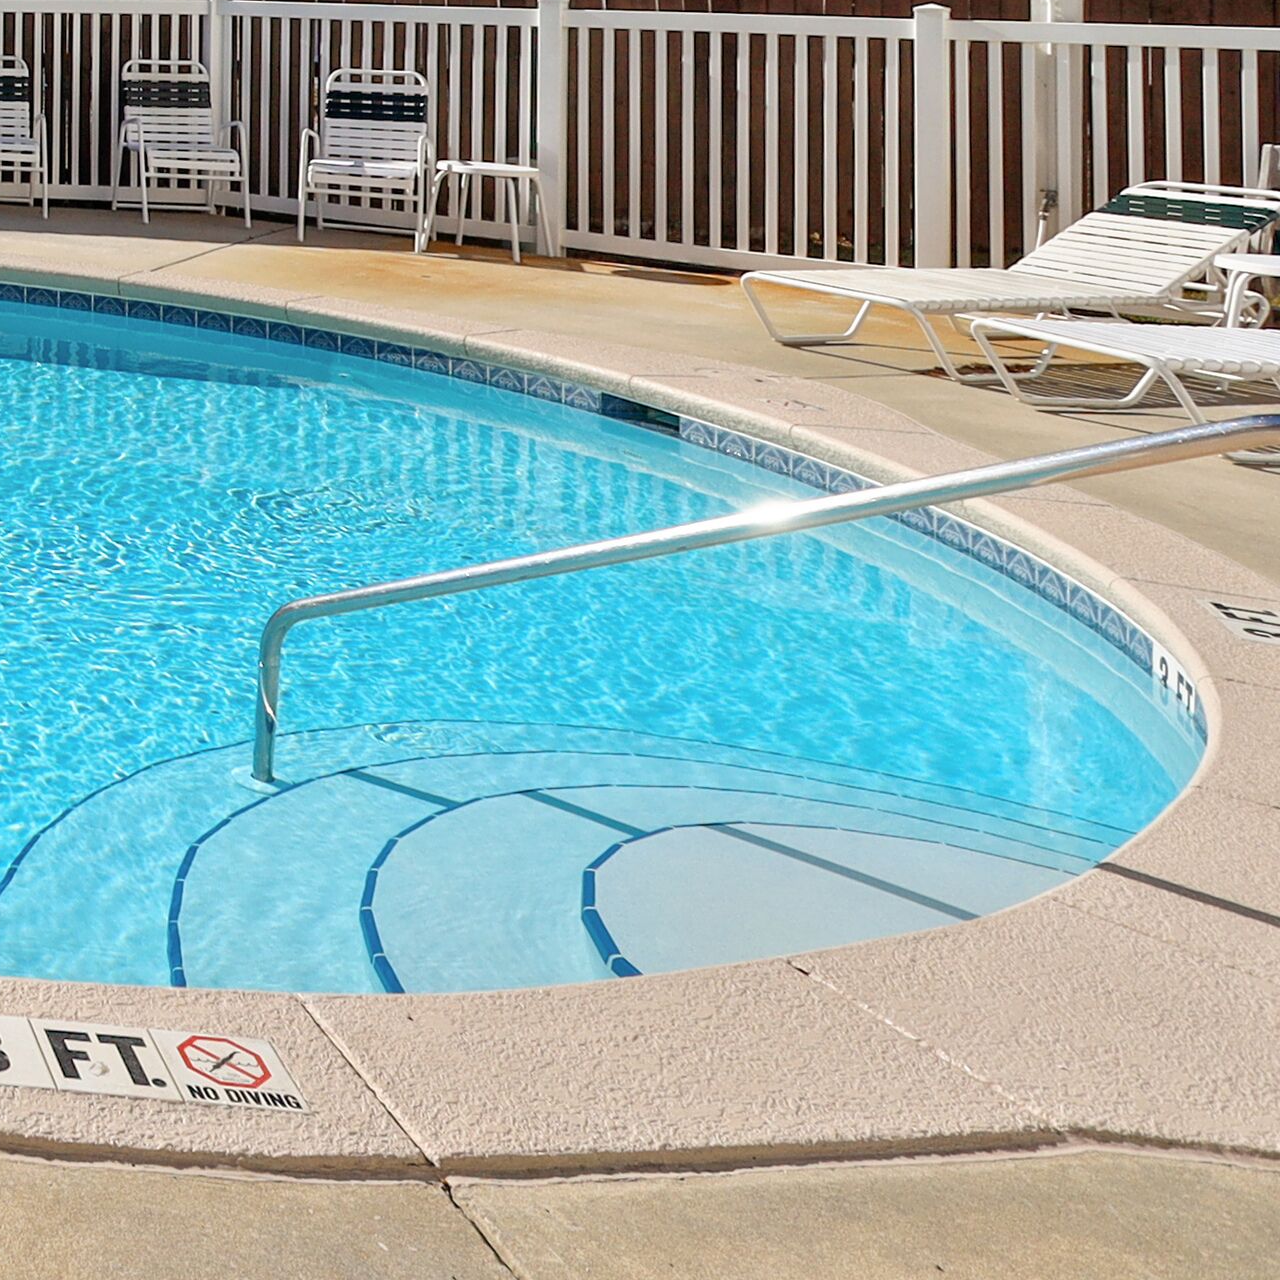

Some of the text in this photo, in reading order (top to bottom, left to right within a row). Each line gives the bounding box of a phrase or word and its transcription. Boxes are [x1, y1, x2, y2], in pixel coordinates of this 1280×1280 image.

[44, 1028, 167, 1088] FT.
[187, 1084, 303, 1111] NO DIVING
